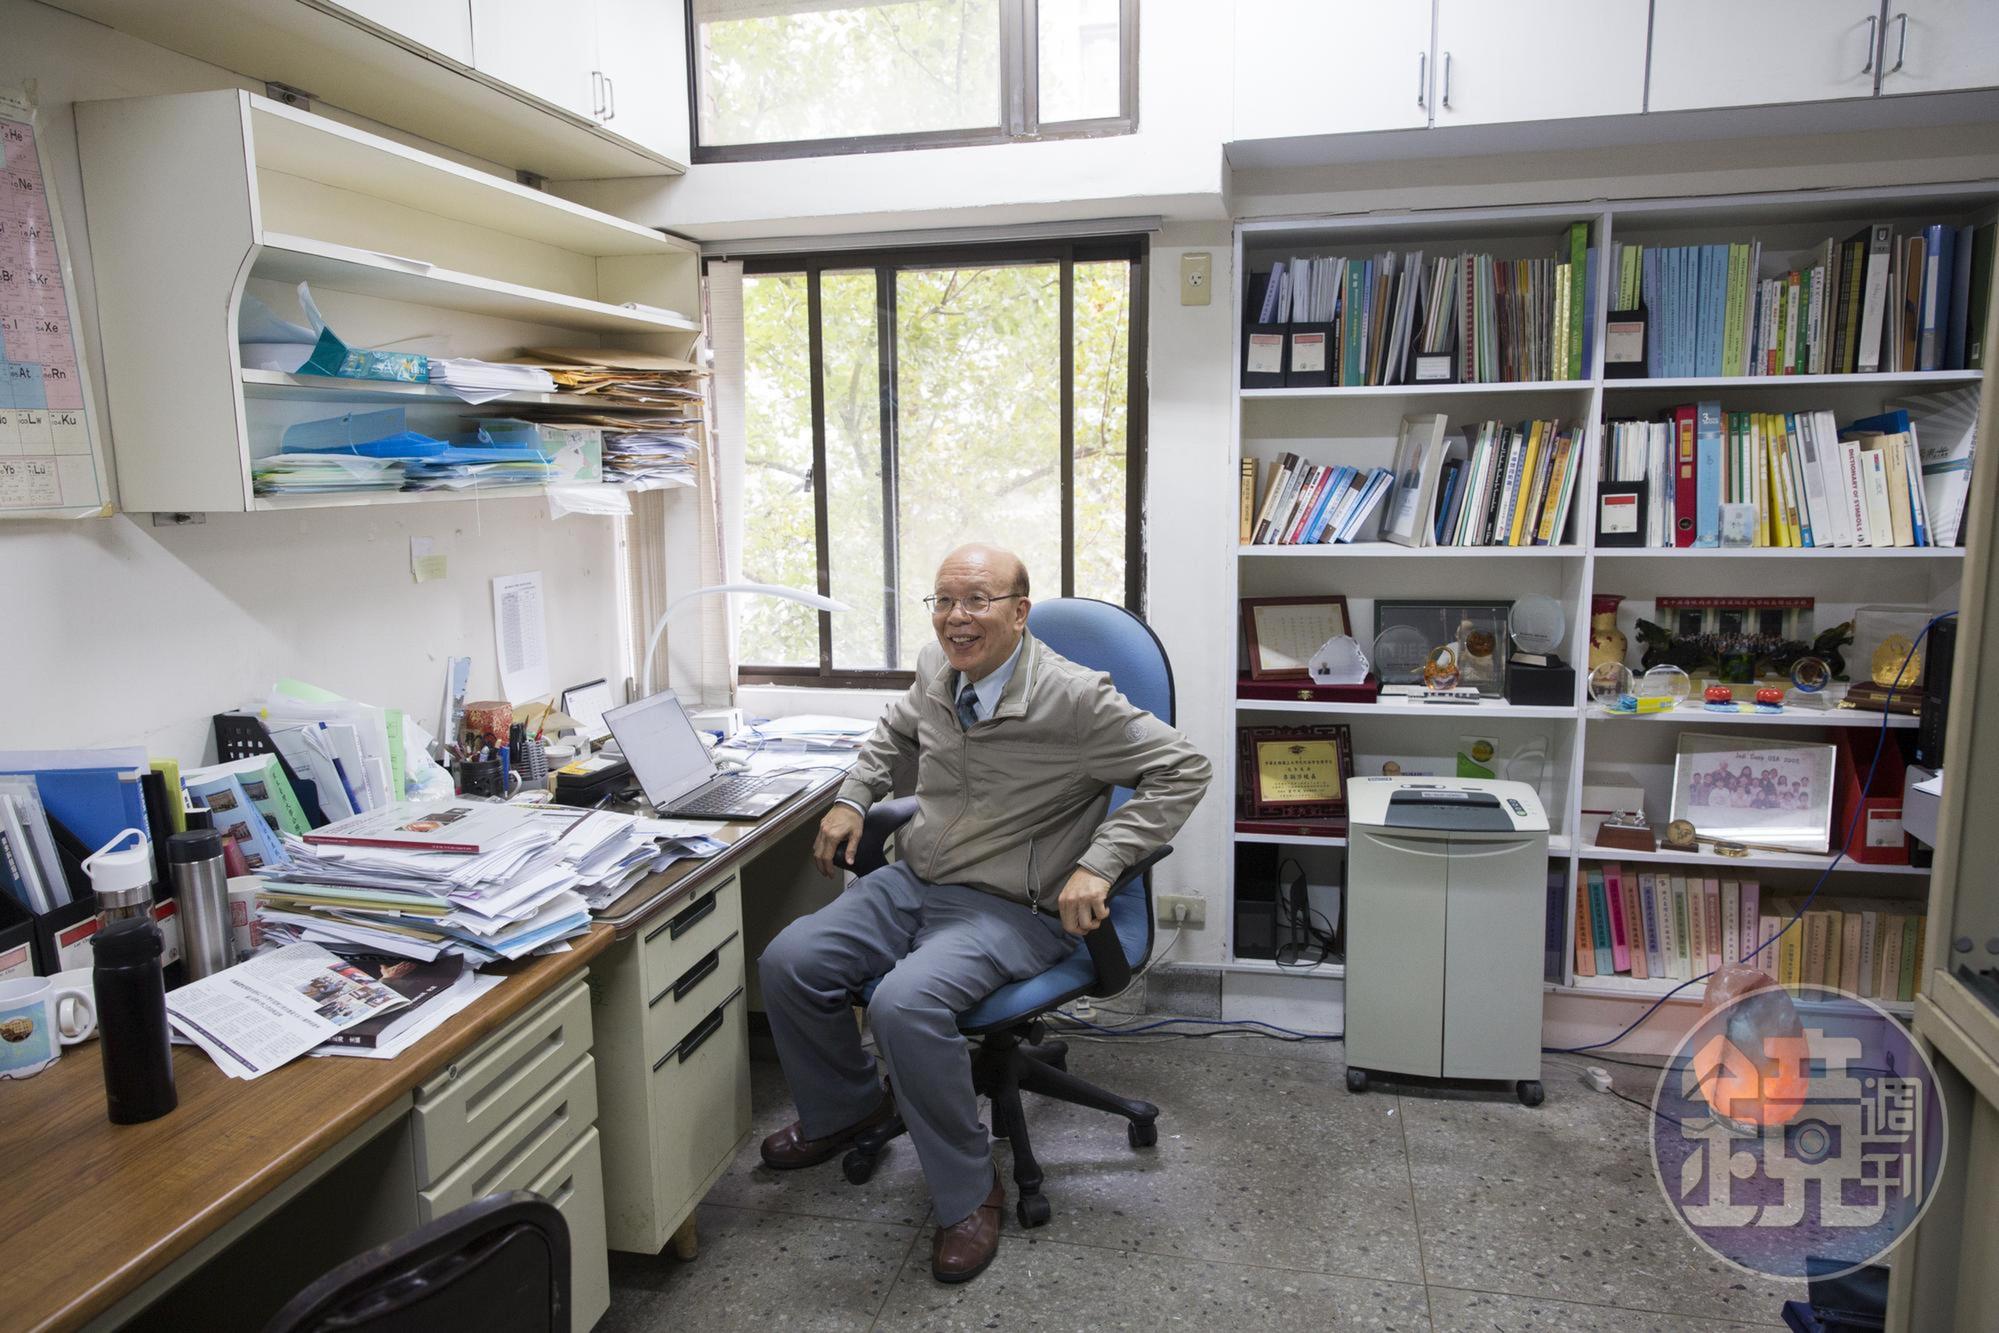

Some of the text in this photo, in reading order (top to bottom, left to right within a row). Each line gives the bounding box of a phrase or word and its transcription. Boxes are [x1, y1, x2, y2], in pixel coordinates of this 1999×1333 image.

[10, 128, 23, 142] He
[19, 178, 33, 190] Ne
[29, 226, 41, 238] Ar
[2, 270, 14, 282] Br
[36, 273, 48, 285] Kr
[44, 321, 59, 333] Xe
[19, 367, 32, 379] At
[52, 368, 67, 380] Rn
[61, 414, 77, 426] Ku
[3, 464, 15, 475] Yb
[34, 464, 46, 476] Lu
[1848, 448, 1858, 489] DICTIONARY
[1854, 499, 1863, 532] SYMBOLS
